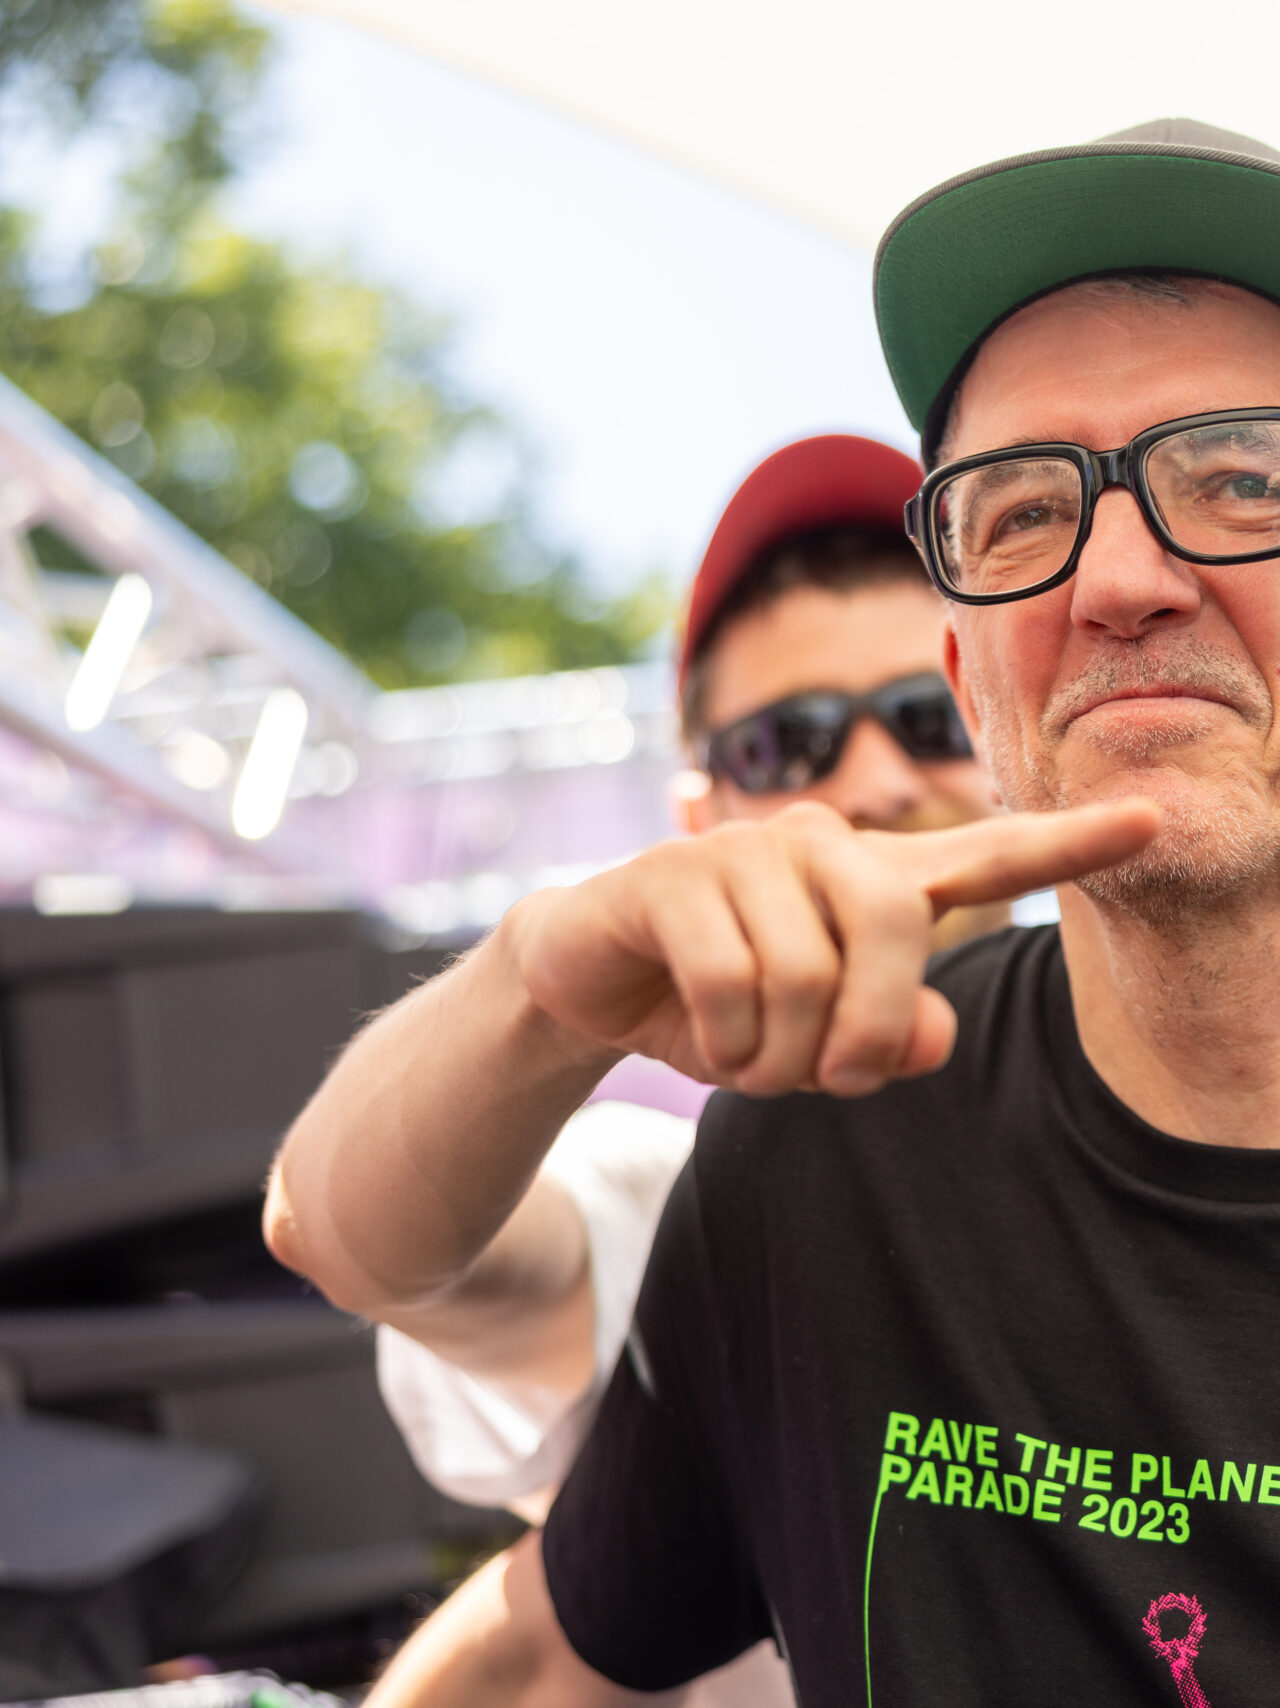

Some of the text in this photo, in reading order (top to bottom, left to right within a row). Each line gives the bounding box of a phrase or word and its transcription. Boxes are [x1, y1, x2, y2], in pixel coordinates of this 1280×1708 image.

[884, 1411, 999, 1468] RAVE
[1015, 1432, 1114, 1492] THE
[879, 1453, 1191, 1544] PARADE 2023
